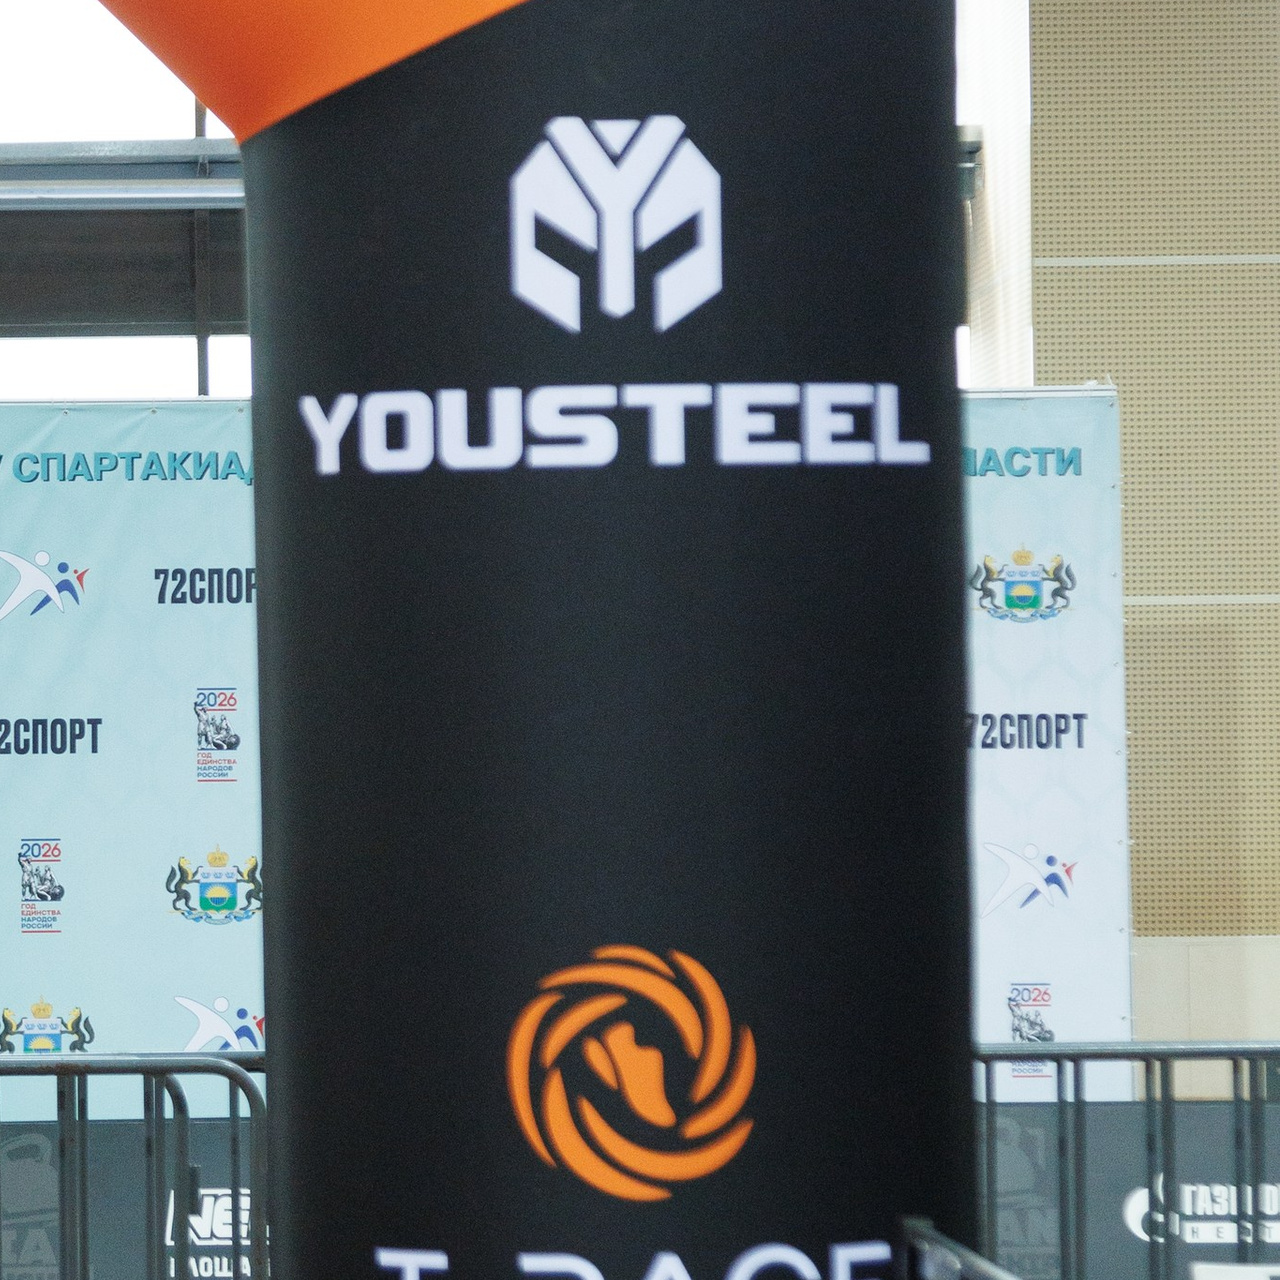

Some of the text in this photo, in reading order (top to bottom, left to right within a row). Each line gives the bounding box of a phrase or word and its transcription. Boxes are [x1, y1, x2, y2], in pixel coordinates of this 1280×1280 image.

[298, 380, 931, 476] YOUSTEEL
[196, 692, 237, 707] 2026
[20, 843, 61, 858] 2026
[1011, 987, 1051, 1003] 2026
